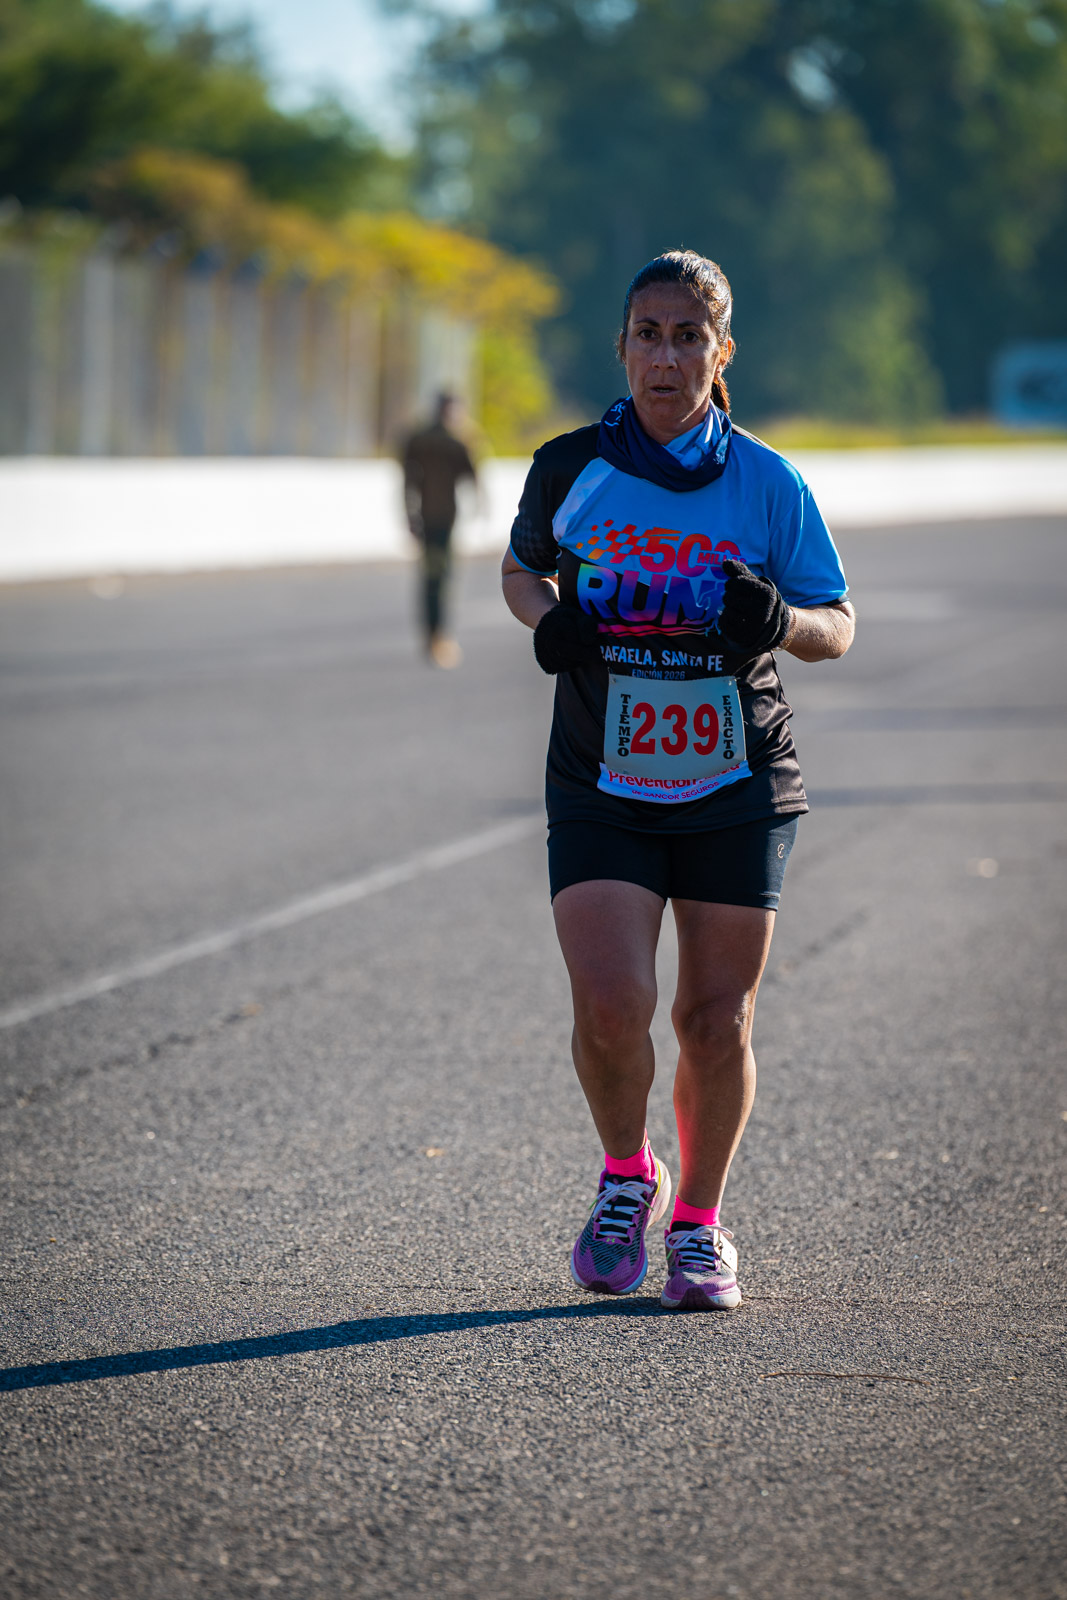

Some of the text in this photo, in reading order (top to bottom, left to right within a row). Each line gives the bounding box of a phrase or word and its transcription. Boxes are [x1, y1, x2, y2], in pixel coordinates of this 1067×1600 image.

[661, 649, 704, 667] SANTA
[707, 655, 724, 672] FE
[664, 671, 685, 680] 2026
[617, 693, 631, 757] TIEMPO
[630, 702, 720, 756] 239
[722, 695, 735, 760] EXACTO
[681, 781, 719, 799] SEGUROS
